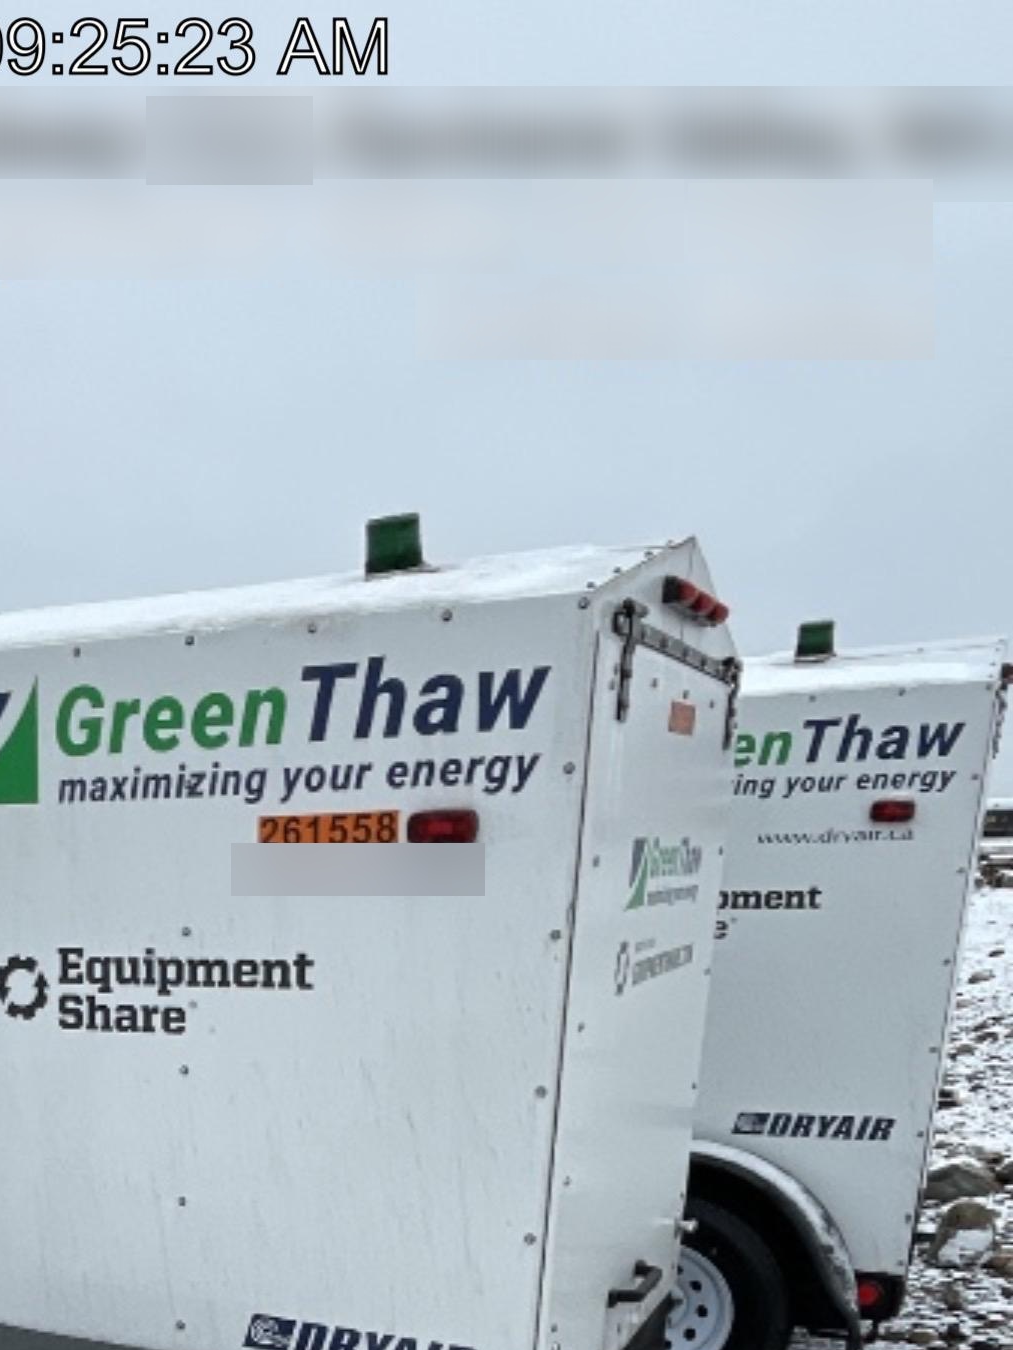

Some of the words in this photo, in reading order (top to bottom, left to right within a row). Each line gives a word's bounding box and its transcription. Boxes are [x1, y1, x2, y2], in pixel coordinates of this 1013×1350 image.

[58, 762, 268, 806] maximizing
[279, 762, 374, 806] your
[385, 752, 542, 797] energy
[782, 773, 848, 800] your
[855, 769, 958, 794] energy
[258, 812, 398, 844] 261558
[57, 945, 316, 997] Equipment
[57, 992, 188, 1036] Share
[767, 1112, 898, 1142] DRYAIR
